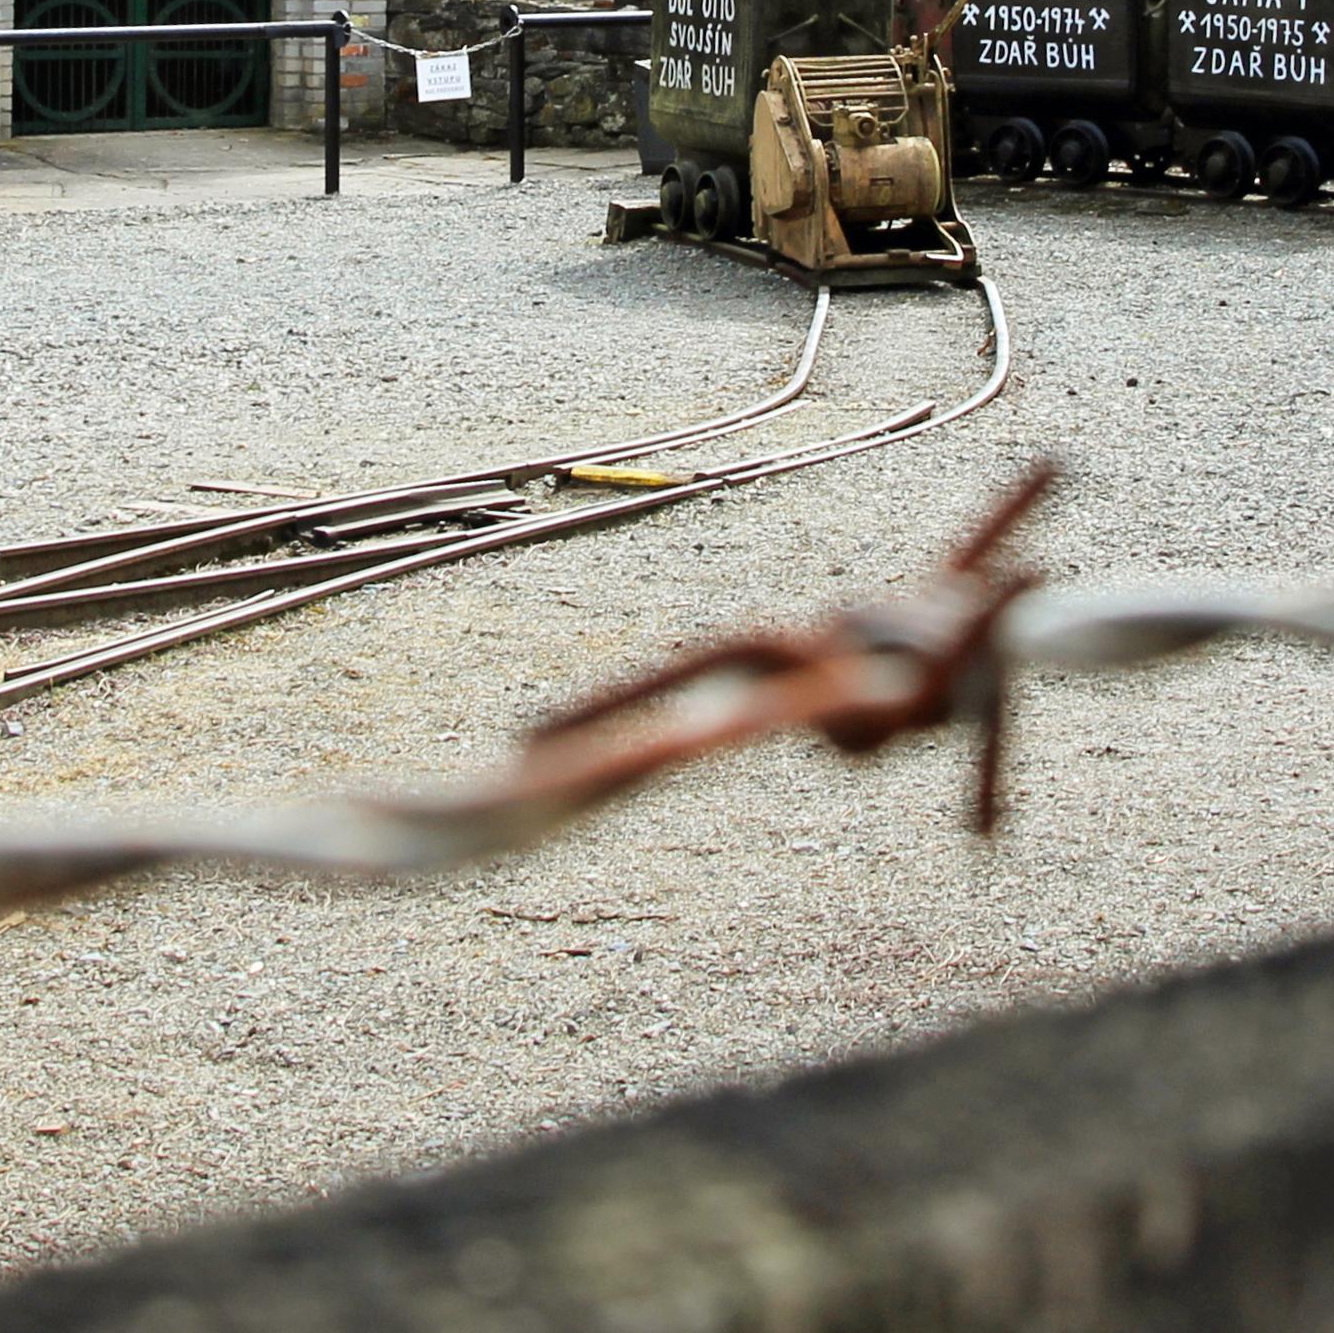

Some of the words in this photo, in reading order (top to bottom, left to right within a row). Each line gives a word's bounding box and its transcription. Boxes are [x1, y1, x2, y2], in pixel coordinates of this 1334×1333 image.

[984, 5, 1086, 35] 1950-1974
[1199, 12, 1305, 46] 1950-1975
[669, 20, 733, 56] SVOJŠÍN
[978, 35, 1039, 66] ZDAŘ
[1045, 38, 1095, 70] BŮH
[659, 54, 692, 90] ZDAŘ
[701, 58, 735, 97] BŮH
[1191, 44, 1264, 79] ZDAŘ
[1273, 48, 1326, 85] BŮH
